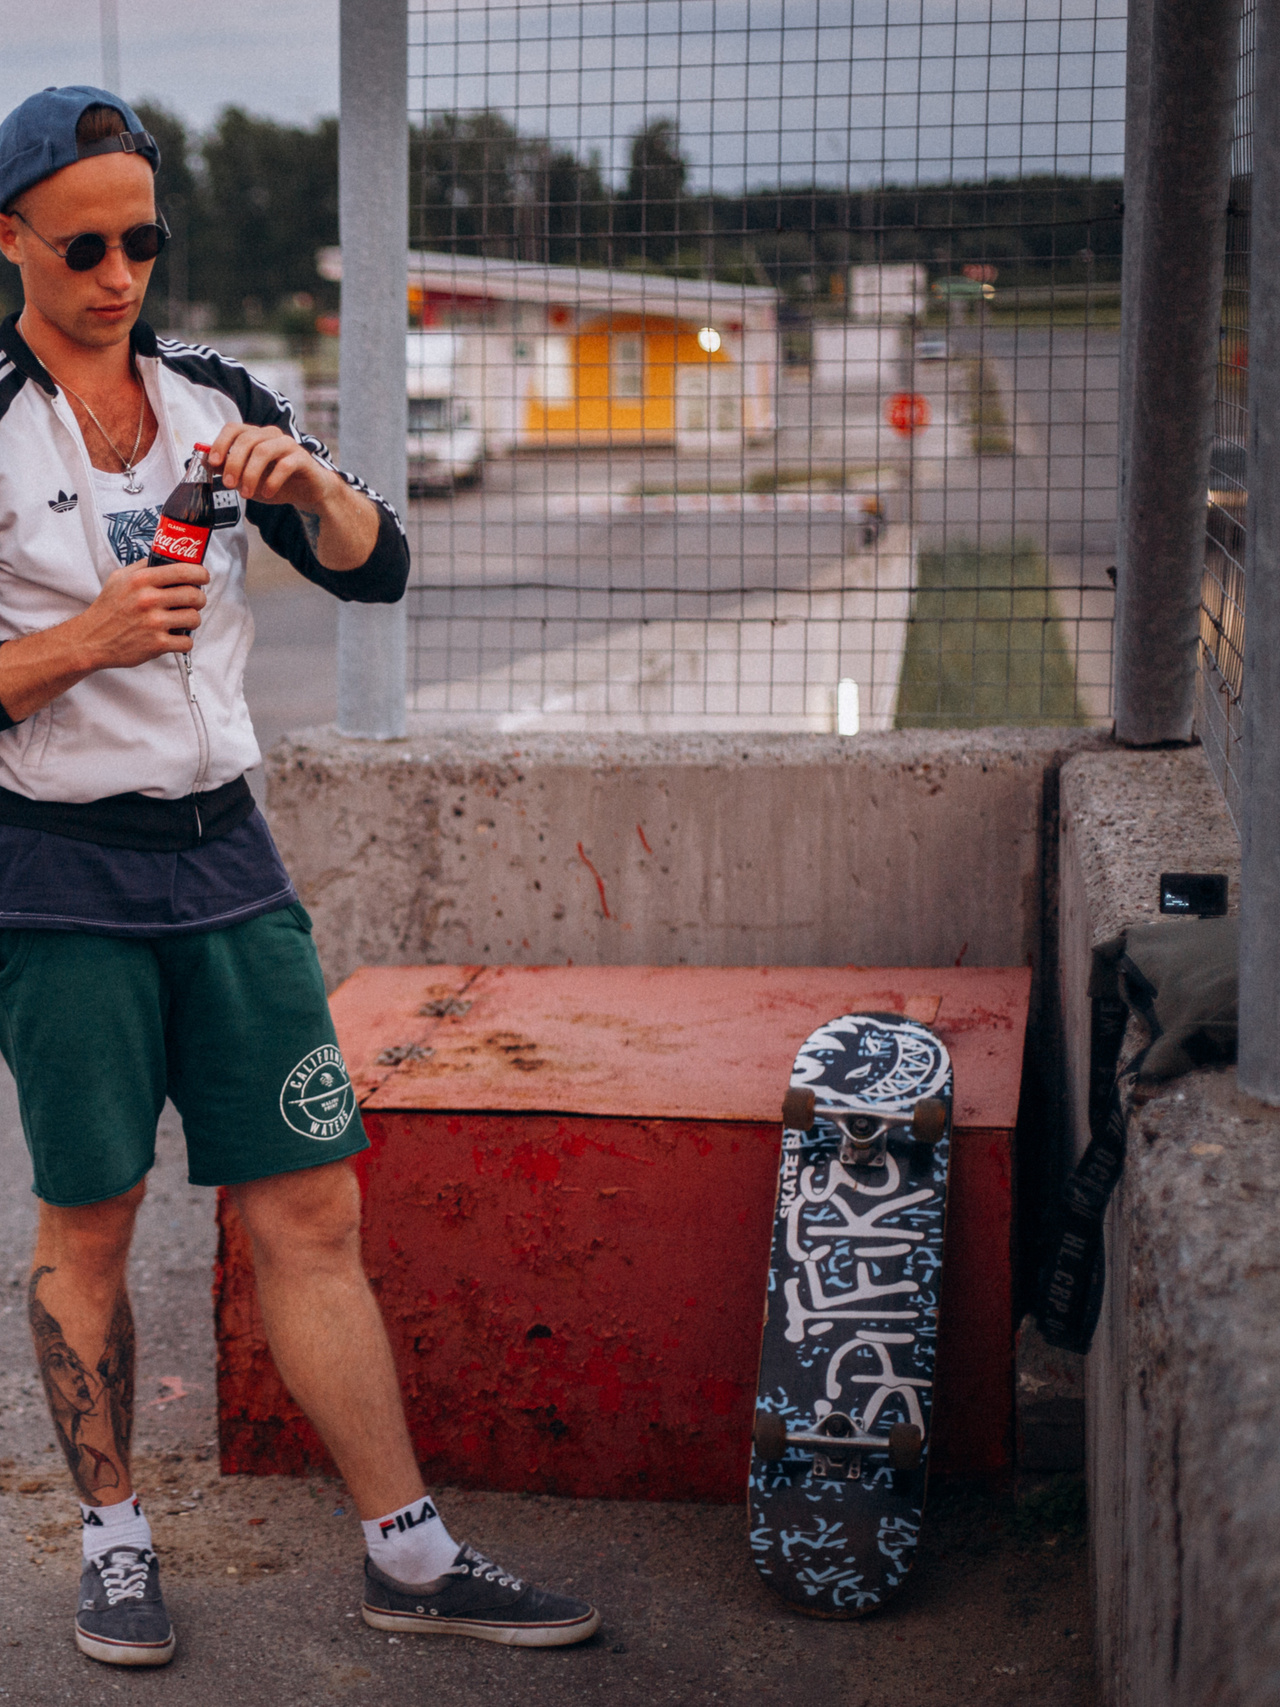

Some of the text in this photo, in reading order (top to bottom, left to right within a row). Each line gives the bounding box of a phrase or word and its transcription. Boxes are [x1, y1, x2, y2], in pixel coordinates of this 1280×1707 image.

[153, 528, 203, 558] Coca-Cola
[167, 523, 187, 533] CLASSIC
[309, 1110, 349, 1136] WATERS
[779, 1154, 800, 1218] SKATE
[379, 1501, 437, 1540] FILA
